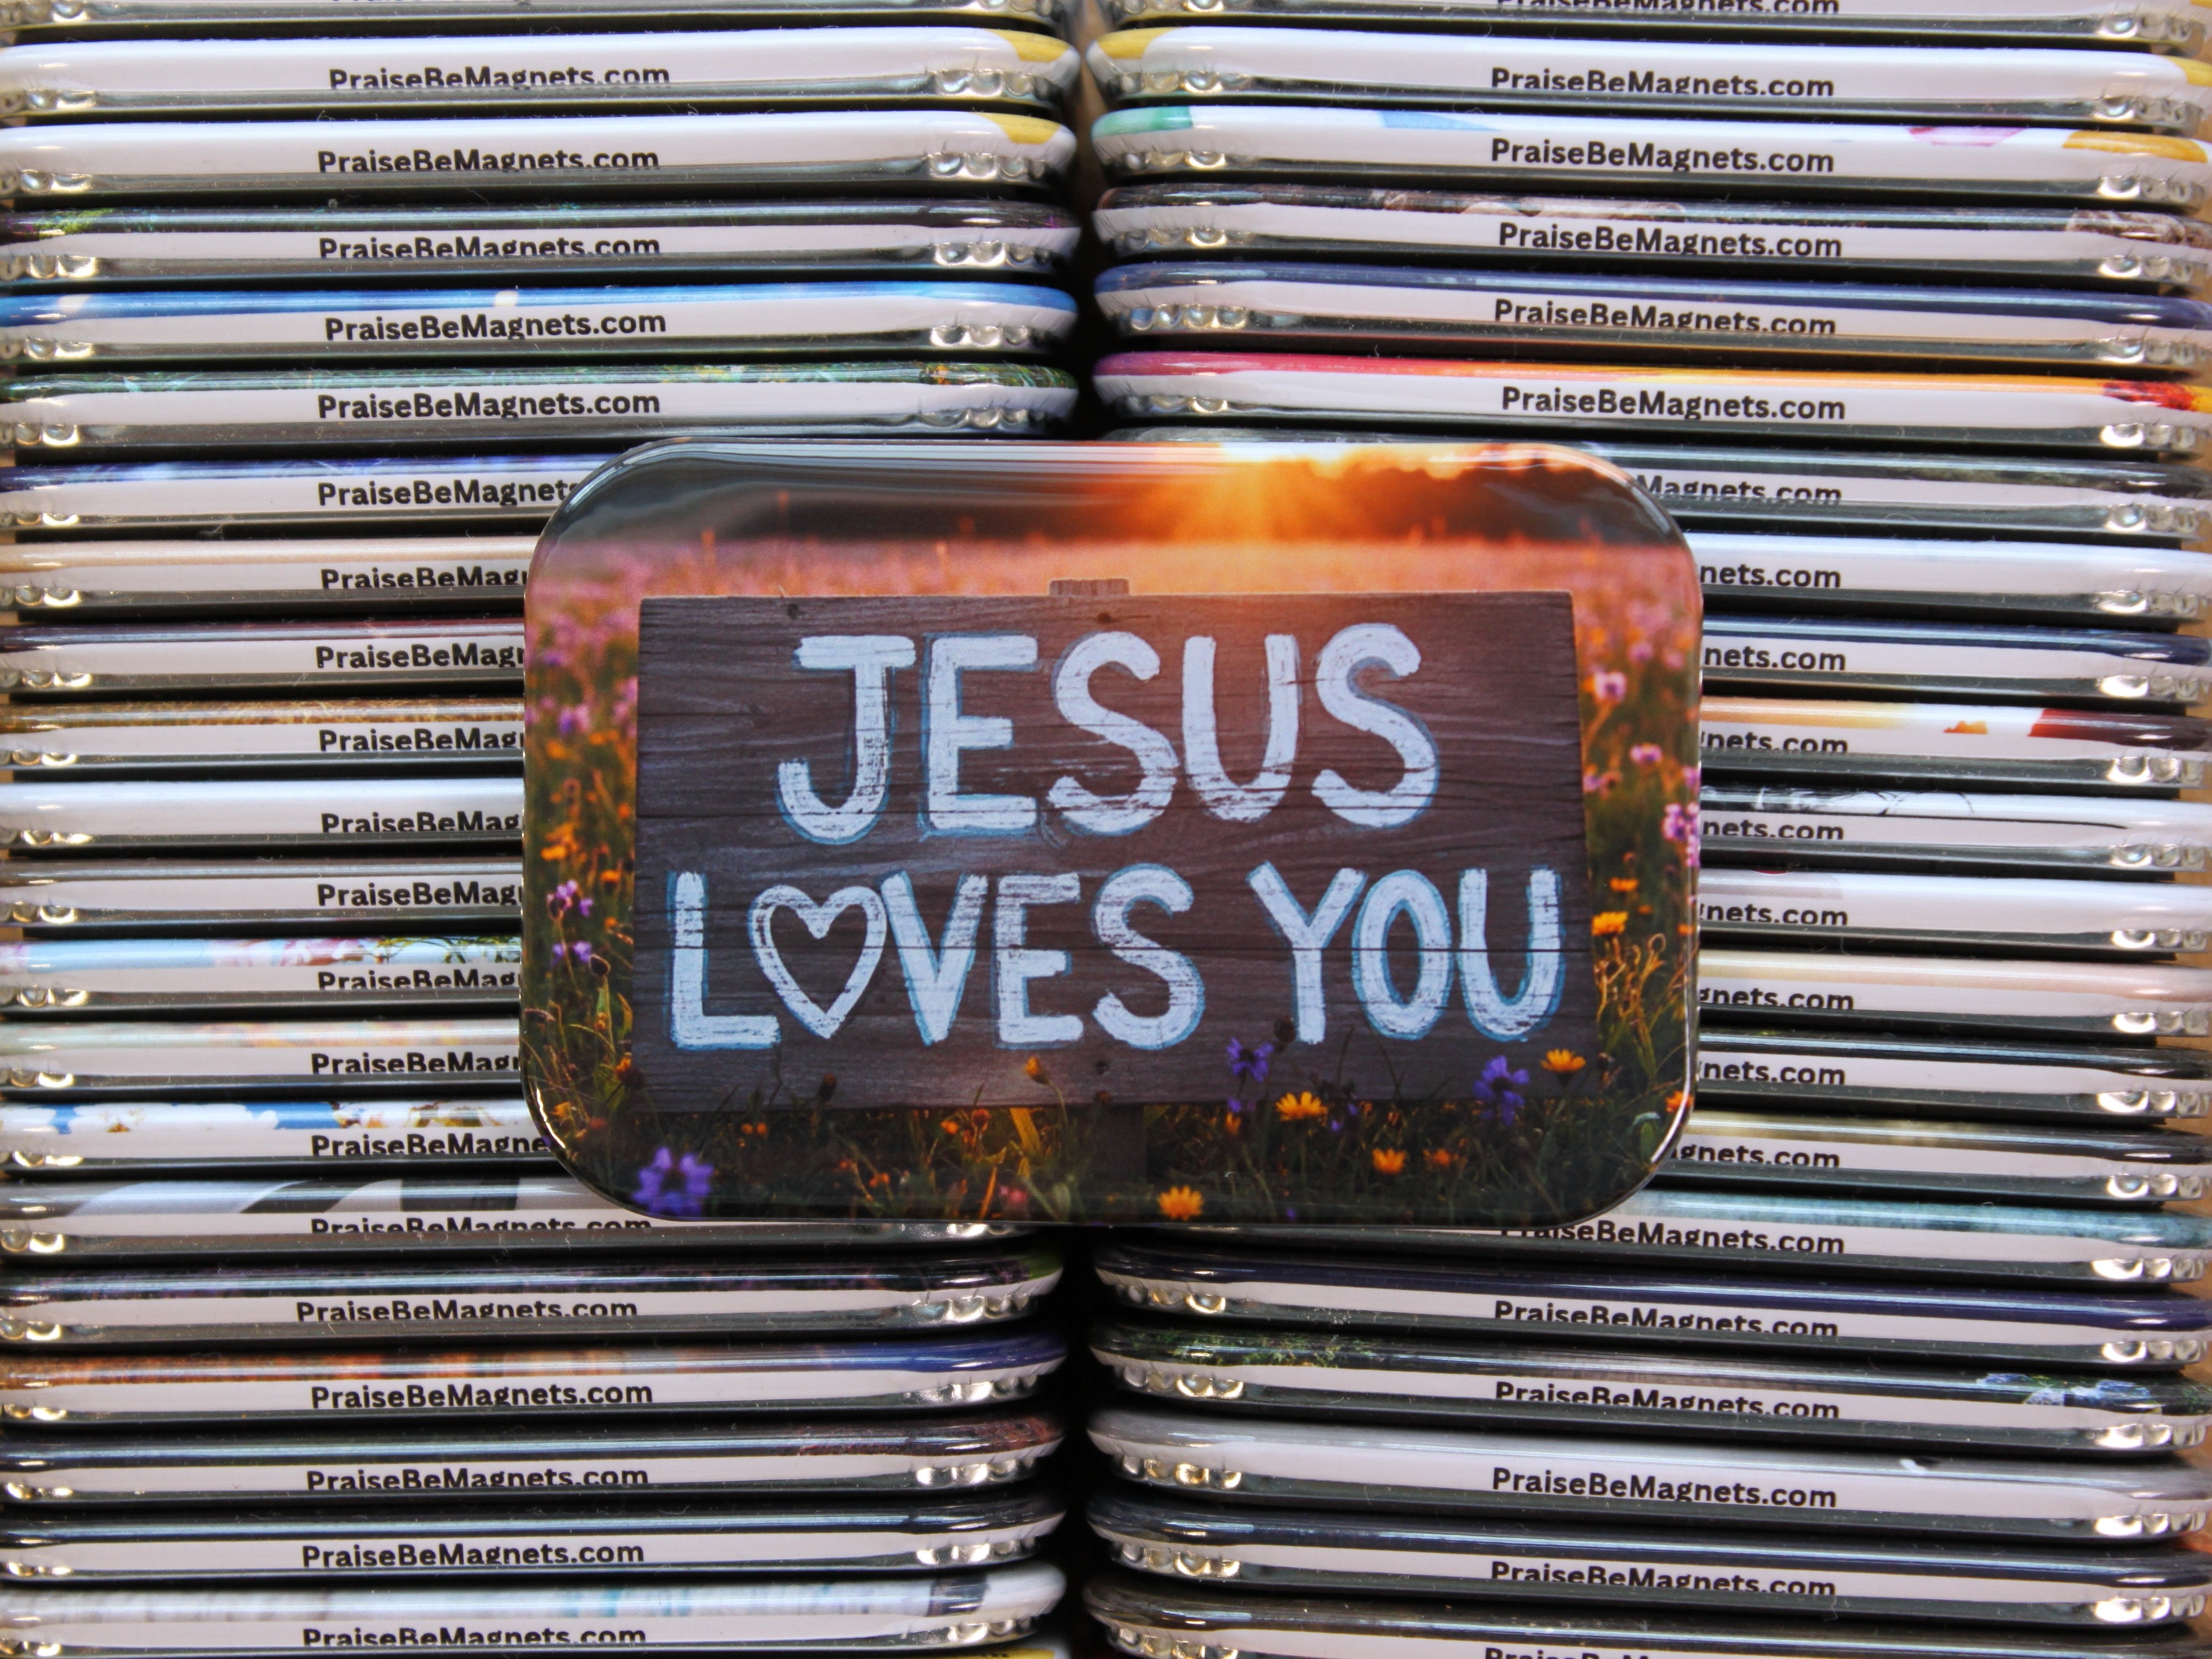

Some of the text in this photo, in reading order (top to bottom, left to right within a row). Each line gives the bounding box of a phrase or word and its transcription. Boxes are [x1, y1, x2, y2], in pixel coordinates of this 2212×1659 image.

[1492, 68, 1833, 96] PraiseBeMagnets.com
[318, 150, 659, 173] PraiseBeMagnets.com
[1492, 139, 1834, 172] PraiseBeMagnets.com
[1499, 223, 1842, 258] PraiseBeMagnets.com
[326, 314, 666, 341] PraiseBeMagnets.com
[1495, 300, 1835, 334] PraiseBeMagnets.com
[318, 392, 660, 419] PraiseBeMagnets.com
[1502, 386, 1845, 421] PraiseBeMagnets.com
[320, 728, 524, 751] PraiseBeMag
[777, 623, 1440, 845] JESUS
[318, 881, 523, 907] PraiseBeMag
[1700, 903, 1848, 926] nets.com
[1247, 863, 1565, 1042] YOU
[318, 969, 521, 989] PraiseBeMag
[1697, 1060, 1845, 1084] nets.com
[297, 1300, 637, 1322] PraiseBeMagnets.com
[312, 1384, 652, 1409] PraiseBeMagnets.com
[307, 1468, 648, 1491] PraiseBeMagnets.com
[1493, 1467, 1835, 1507] PraiseBeMagnets.com
[303, 1543, 644, 1567] PraiseBeMagnets.com
[1492, 1561, 1835, 1595] PraiseBeMagnets.com
